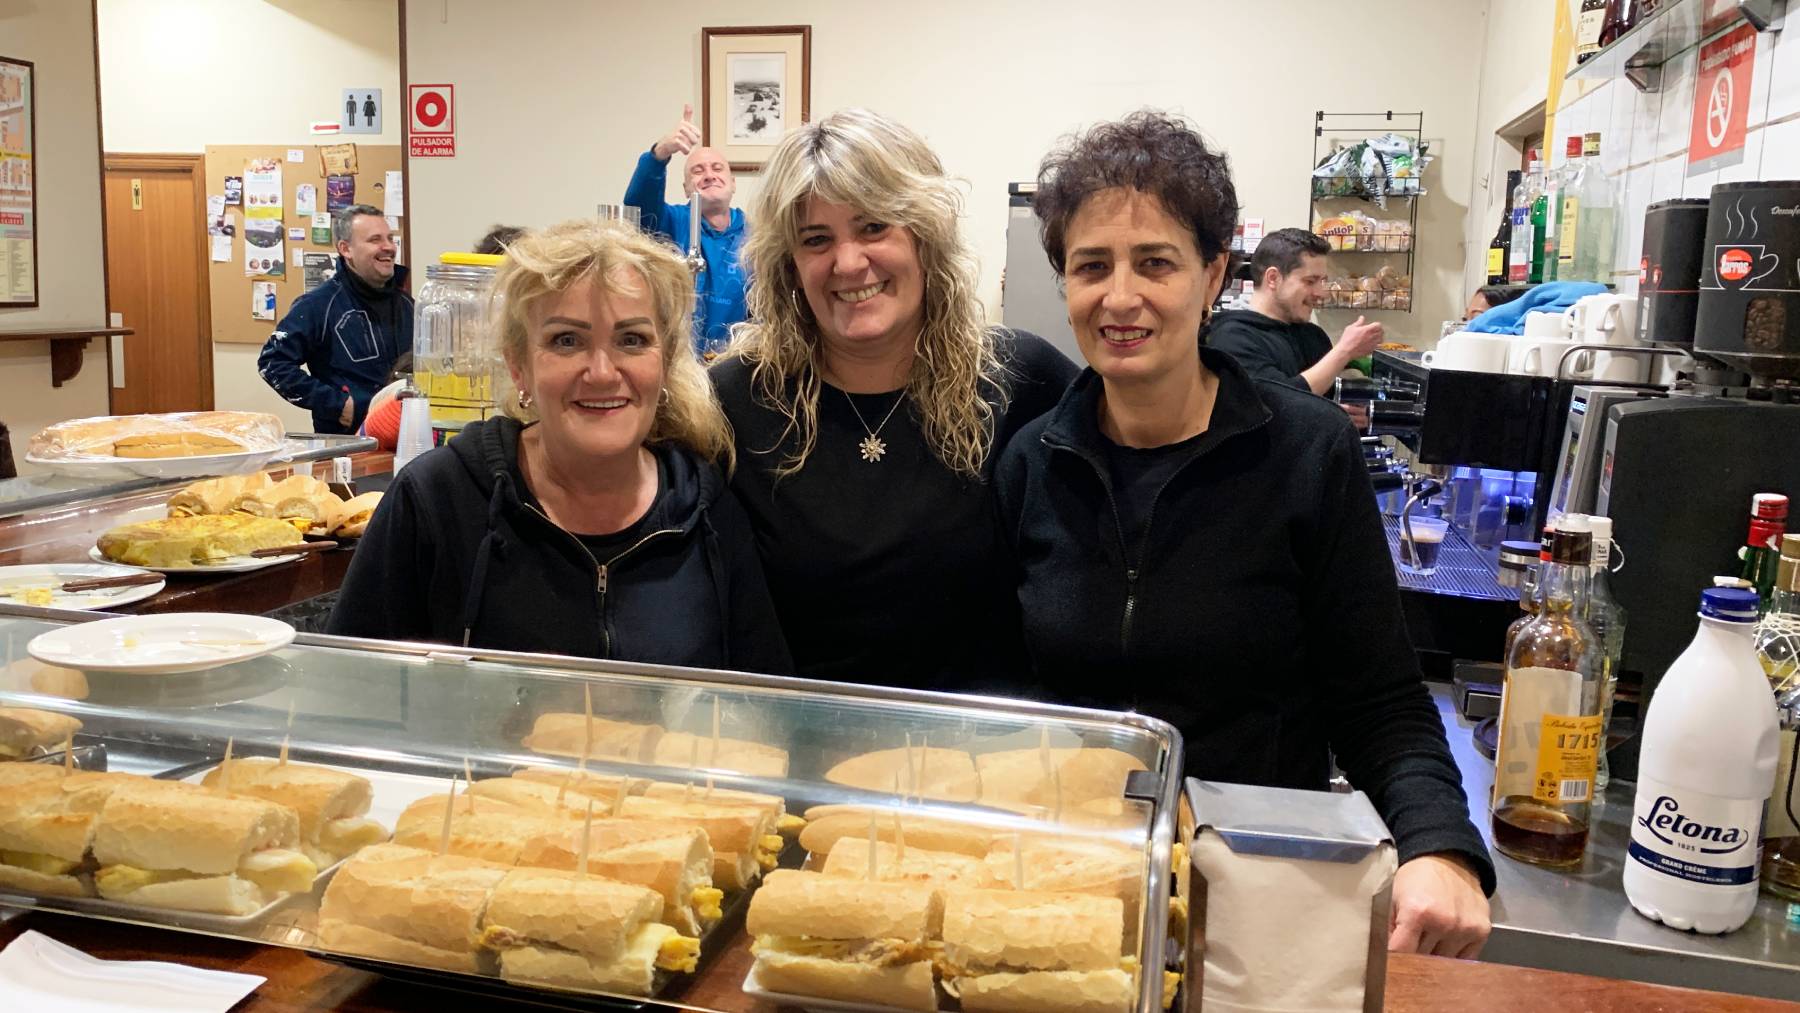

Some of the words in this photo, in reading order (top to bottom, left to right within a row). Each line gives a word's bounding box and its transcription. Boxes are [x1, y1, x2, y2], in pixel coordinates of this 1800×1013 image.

[412, 137, 452, 147] PULSADOR
[411, 147, 422, 156] DE
[423, 147, 454, 156] ALARMA
[1557, 732, 1600, 750] 1715
[1638, 796, 1741, 844] Letona
[1661, 858, 1683, 870] GRAND
